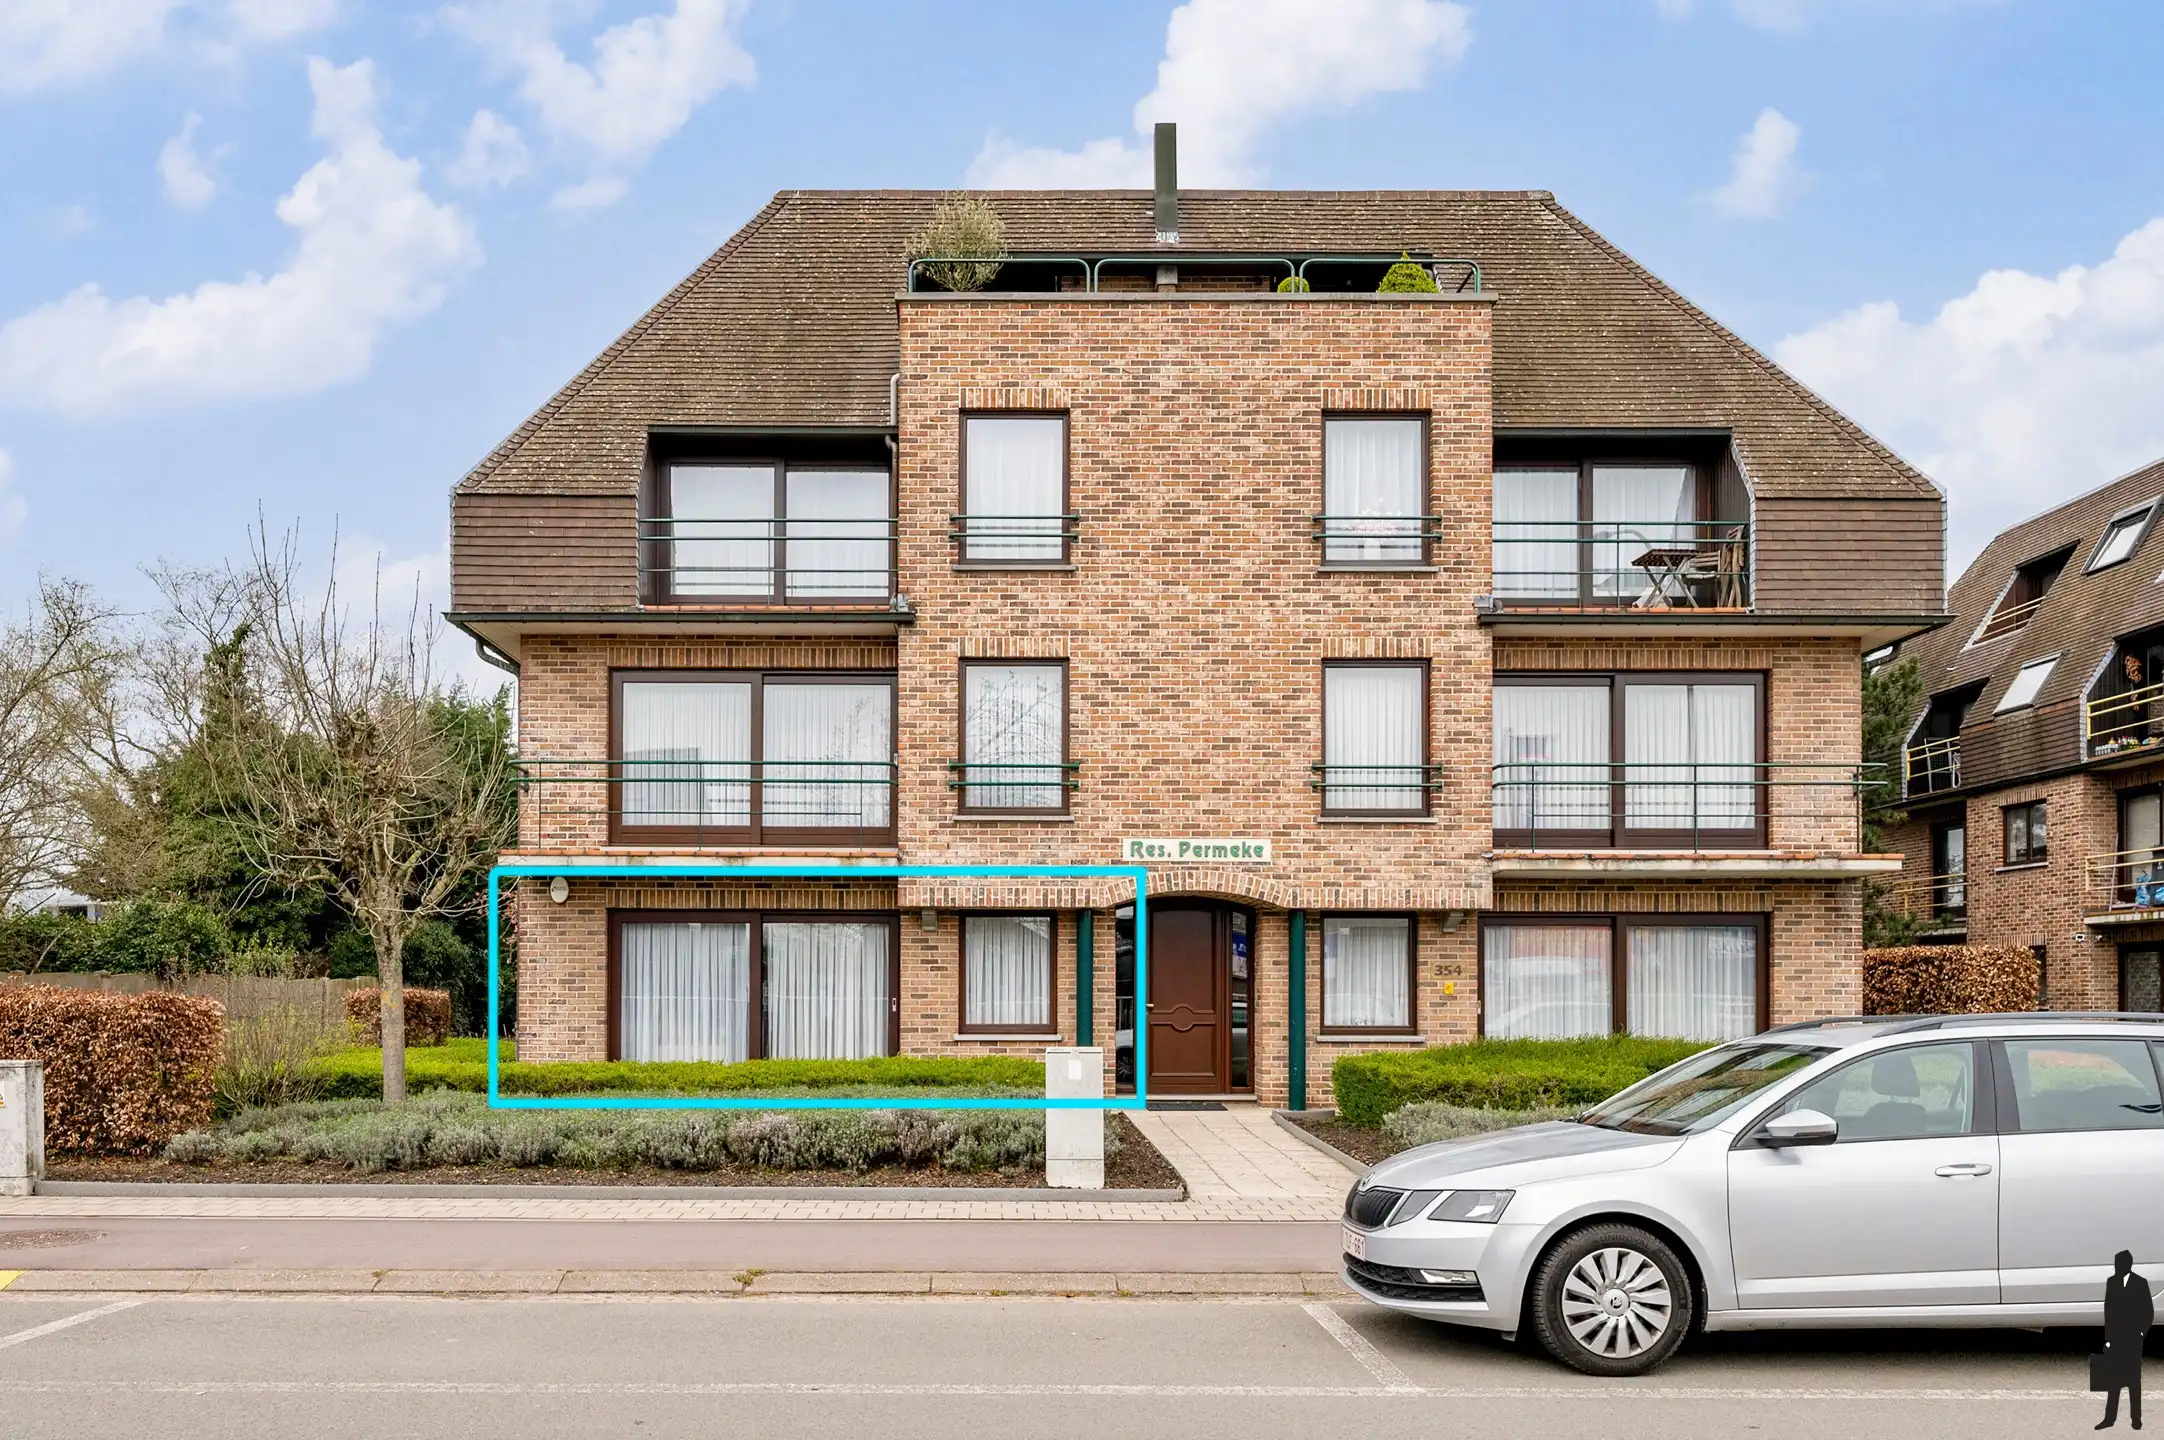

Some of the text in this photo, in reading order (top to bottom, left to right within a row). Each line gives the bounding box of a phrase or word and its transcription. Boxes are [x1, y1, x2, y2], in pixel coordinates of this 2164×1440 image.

[1130, 840, 1265, 859] Res. Permeke
[1434, 964, 1463, 976] 354
